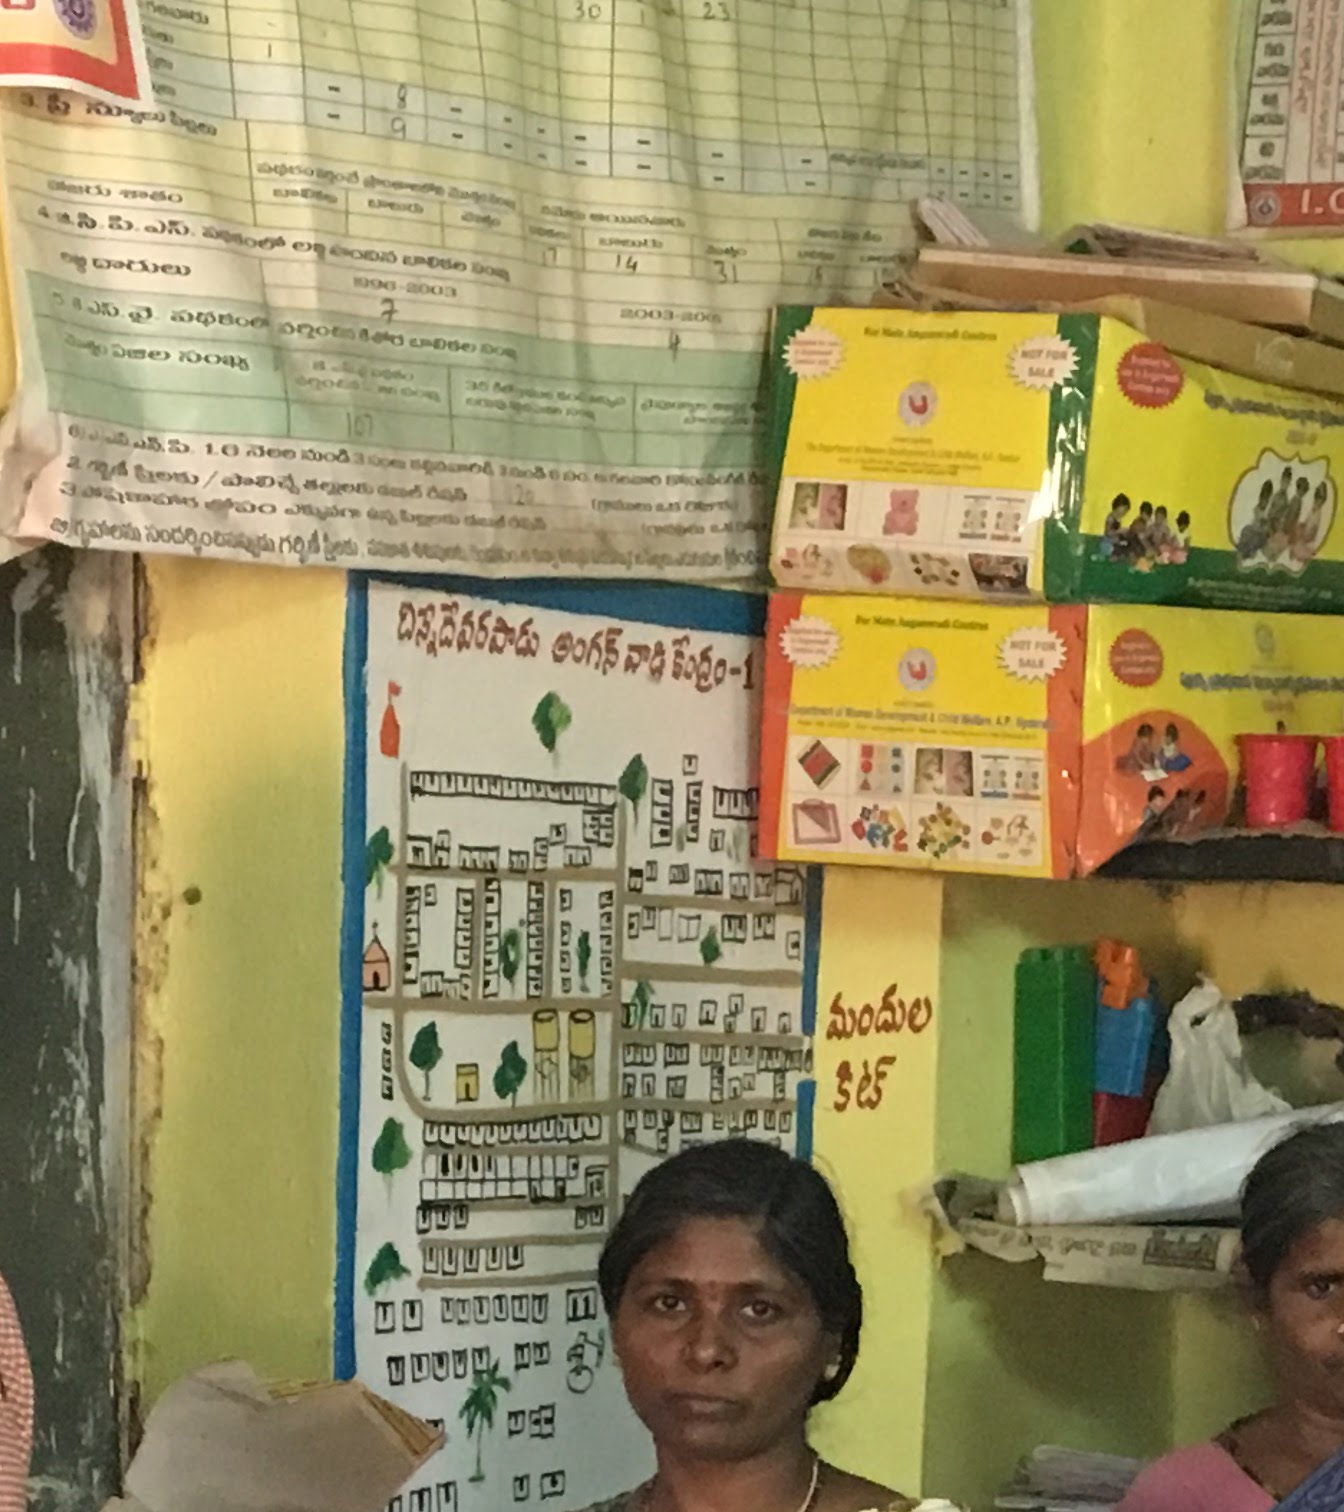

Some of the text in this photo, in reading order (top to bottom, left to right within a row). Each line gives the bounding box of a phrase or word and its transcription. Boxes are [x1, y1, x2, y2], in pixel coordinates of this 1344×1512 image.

[1028, 367, 1055, 379] SALE
[1018, 658, 1045, 670] SALE
[825, 983, 933, 1042] మందుల
[832, 1055, 897, 1112] కిట్
